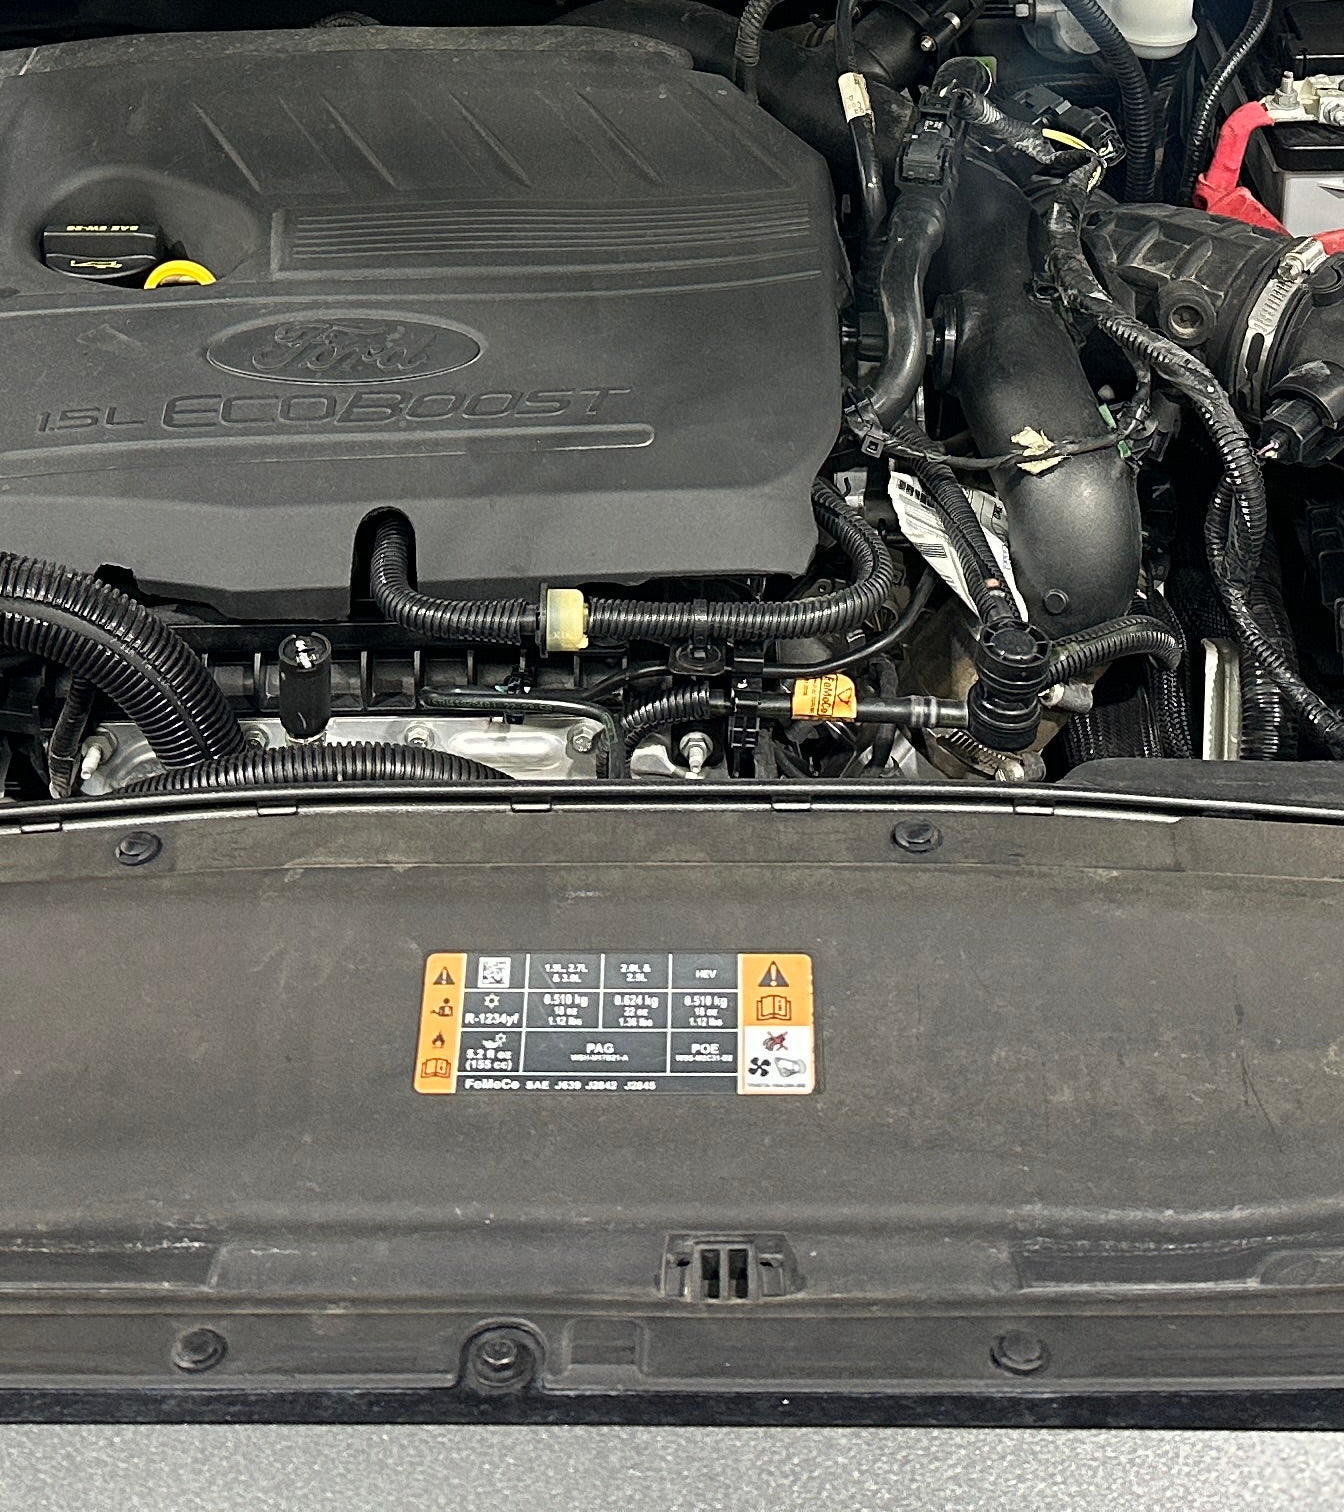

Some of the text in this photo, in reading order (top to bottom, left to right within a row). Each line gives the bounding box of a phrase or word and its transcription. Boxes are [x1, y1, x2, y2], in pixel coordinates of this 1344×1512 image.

[251, 322, 436, 371] Ford
[821, 676, 835, 713] FoMoCo
[696, 970, 717, 978] HEV
[544, 994, 588, 1007] 0.510 kg
[614, 995, 658, 1008] 0.624 kg
[684, 996, 727, 1008] 0.510 kg
[554, 1006, 564, 1015] 18
[624, 1007, 635, 1016] 22
[694, 1007, 705, 1016] 18
[464, 1012, 520, 1026] R-1234yf
[548, 1017, 582, 1025] 1.12 lbs
[639, 1018, 653, 1026] lbs
[689, 1017, 723, 1026] 1.12 lbs
[586, 1043, 614, 1053] PAG
[691, 1044, 719, 1054] POE
[486, 1049, 495, 1059] fl
[497, 1051, 512, 1059] oz
[465, 1060, 513, 1071] (155 cc)
[464, 1079, 520, 1090] FoMoCo
[525, 1081, 550, 1090] SAE
[554, 1081, 582, 1090] J639
